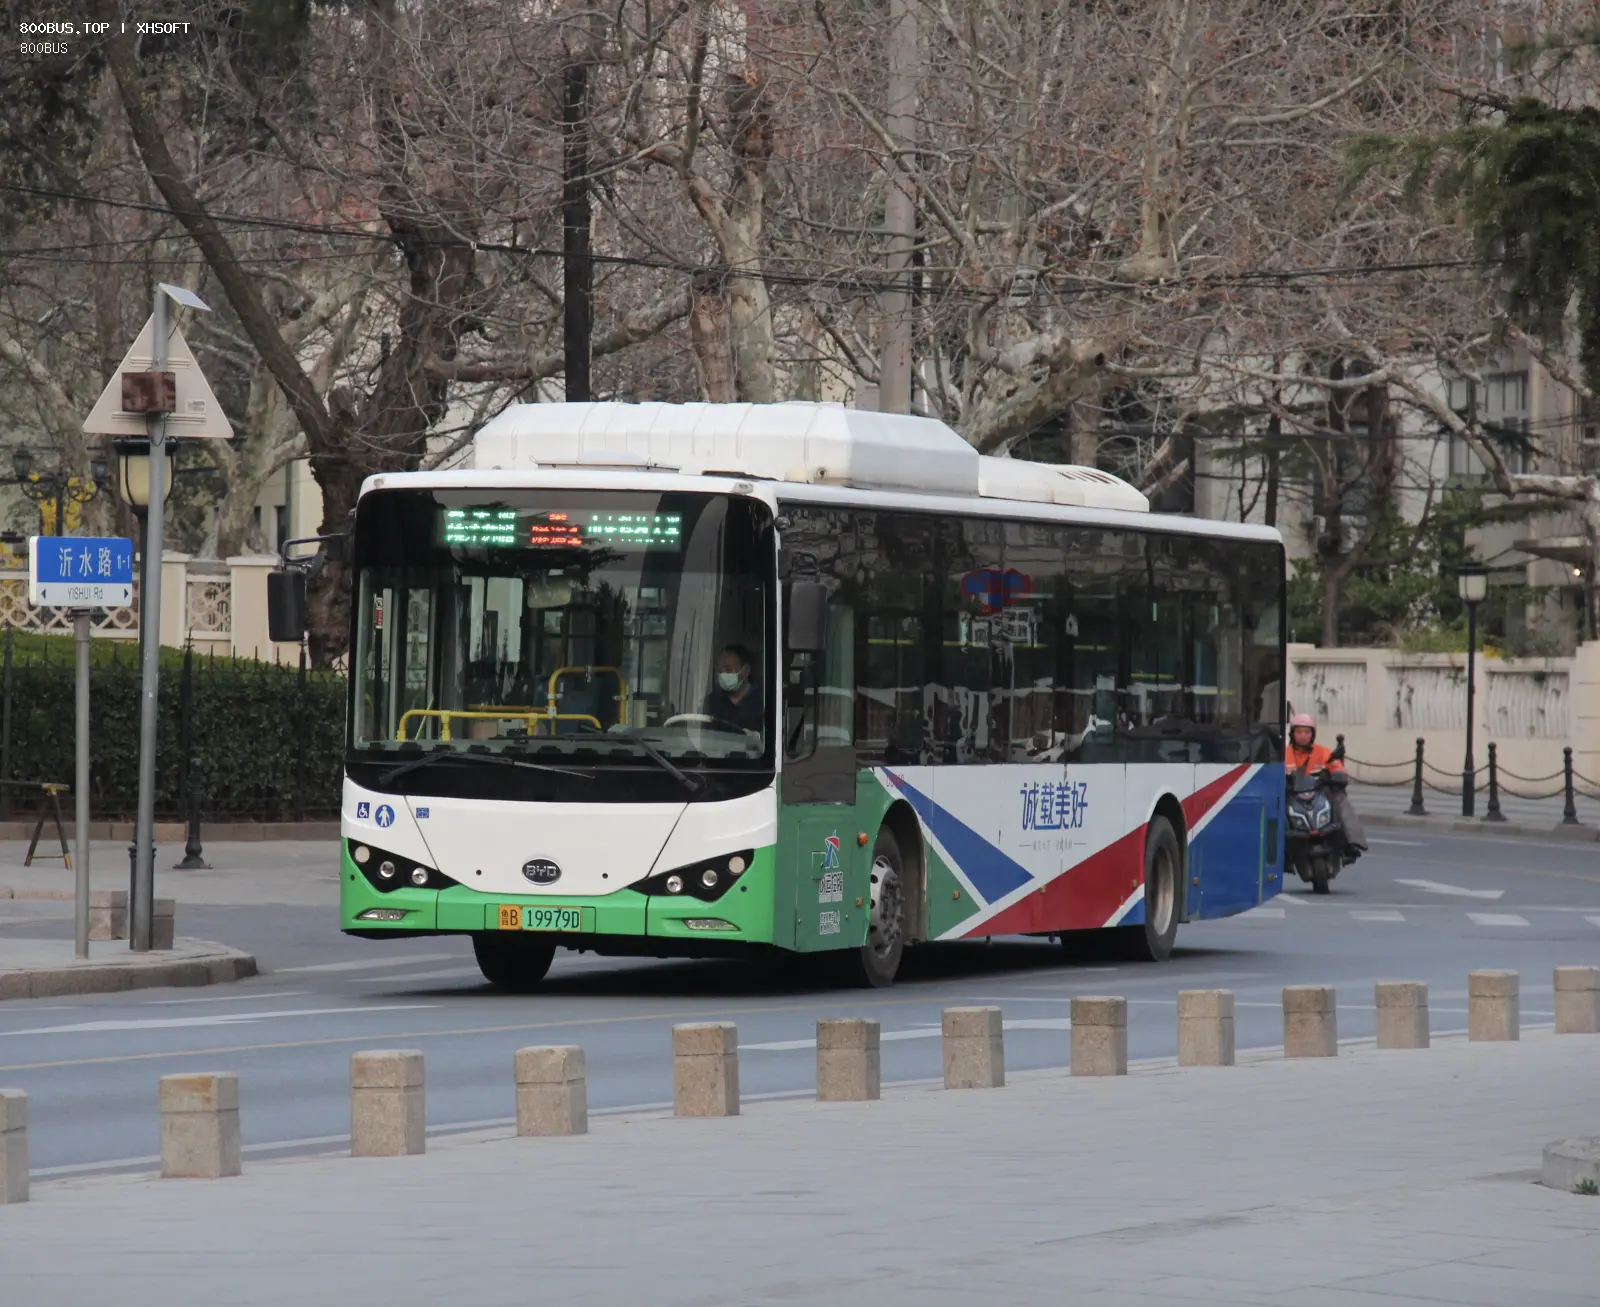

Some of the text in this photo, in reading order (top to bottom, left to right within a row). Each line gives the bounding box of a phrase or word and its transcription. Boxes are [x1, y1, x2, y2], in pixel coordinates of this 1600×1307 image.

[58, 546, 112, 577] 沂水路
[67, 586, 104, 600] YISHUI Rd
[1020, 780, 1088, 830] 诚载美好
[525, 864, 557, 877] BYD
